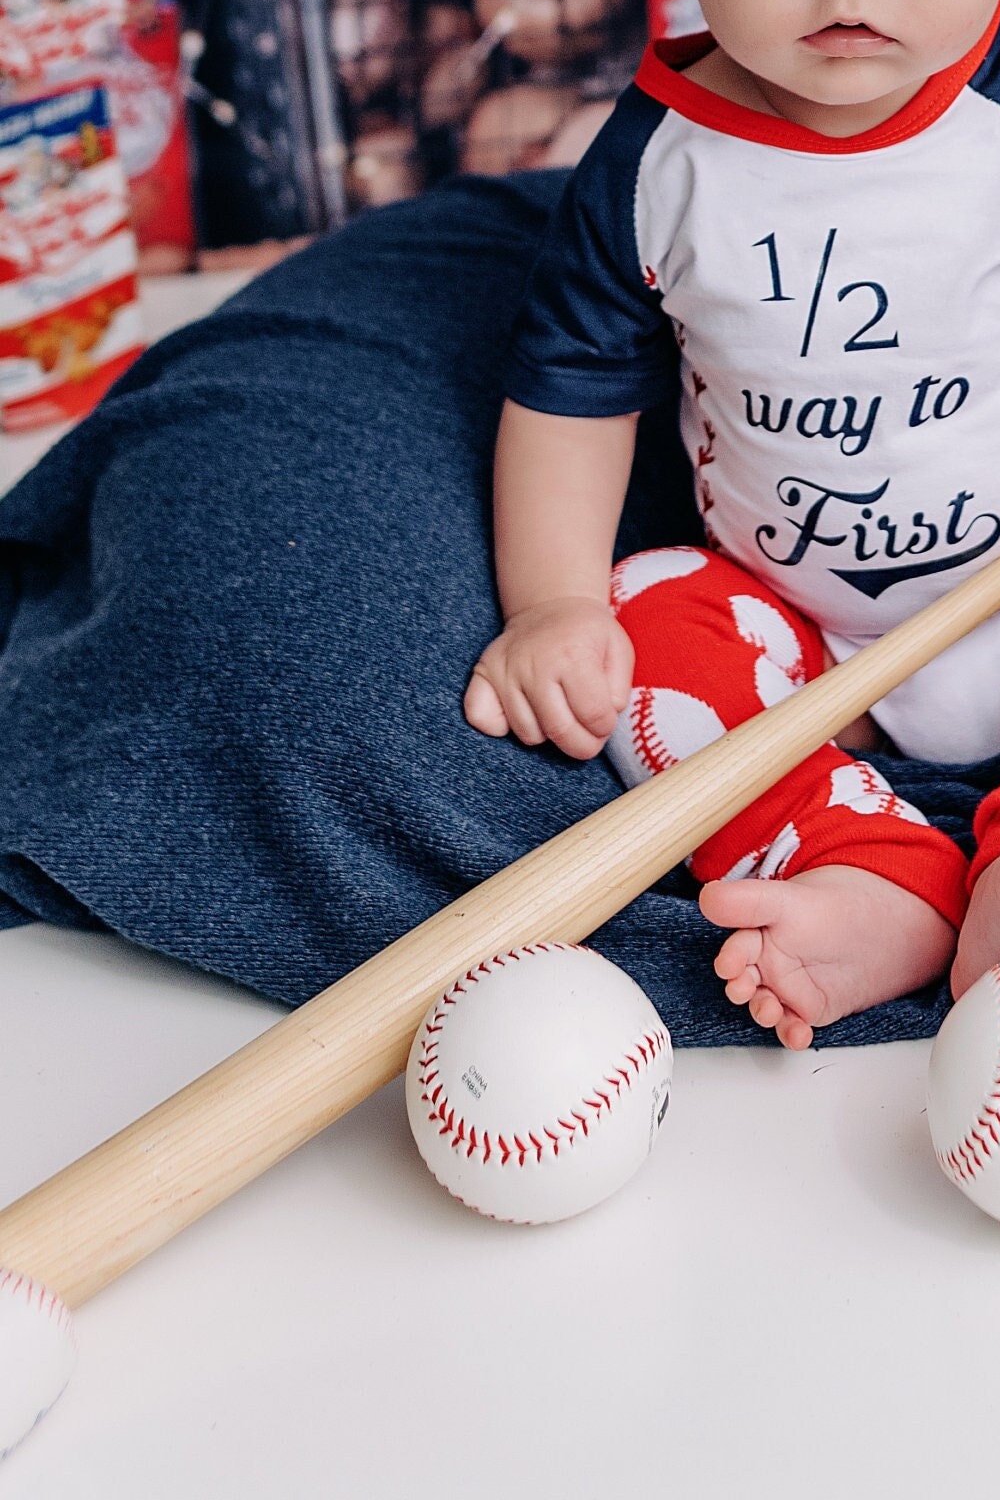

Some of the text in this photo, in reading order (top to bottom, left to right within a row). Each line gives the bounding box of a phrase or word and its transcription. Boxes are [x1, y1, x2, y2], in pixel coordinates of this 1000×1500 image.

[752, 228, 900, 358] 1/2
[742, 375, 970, 457] way to
